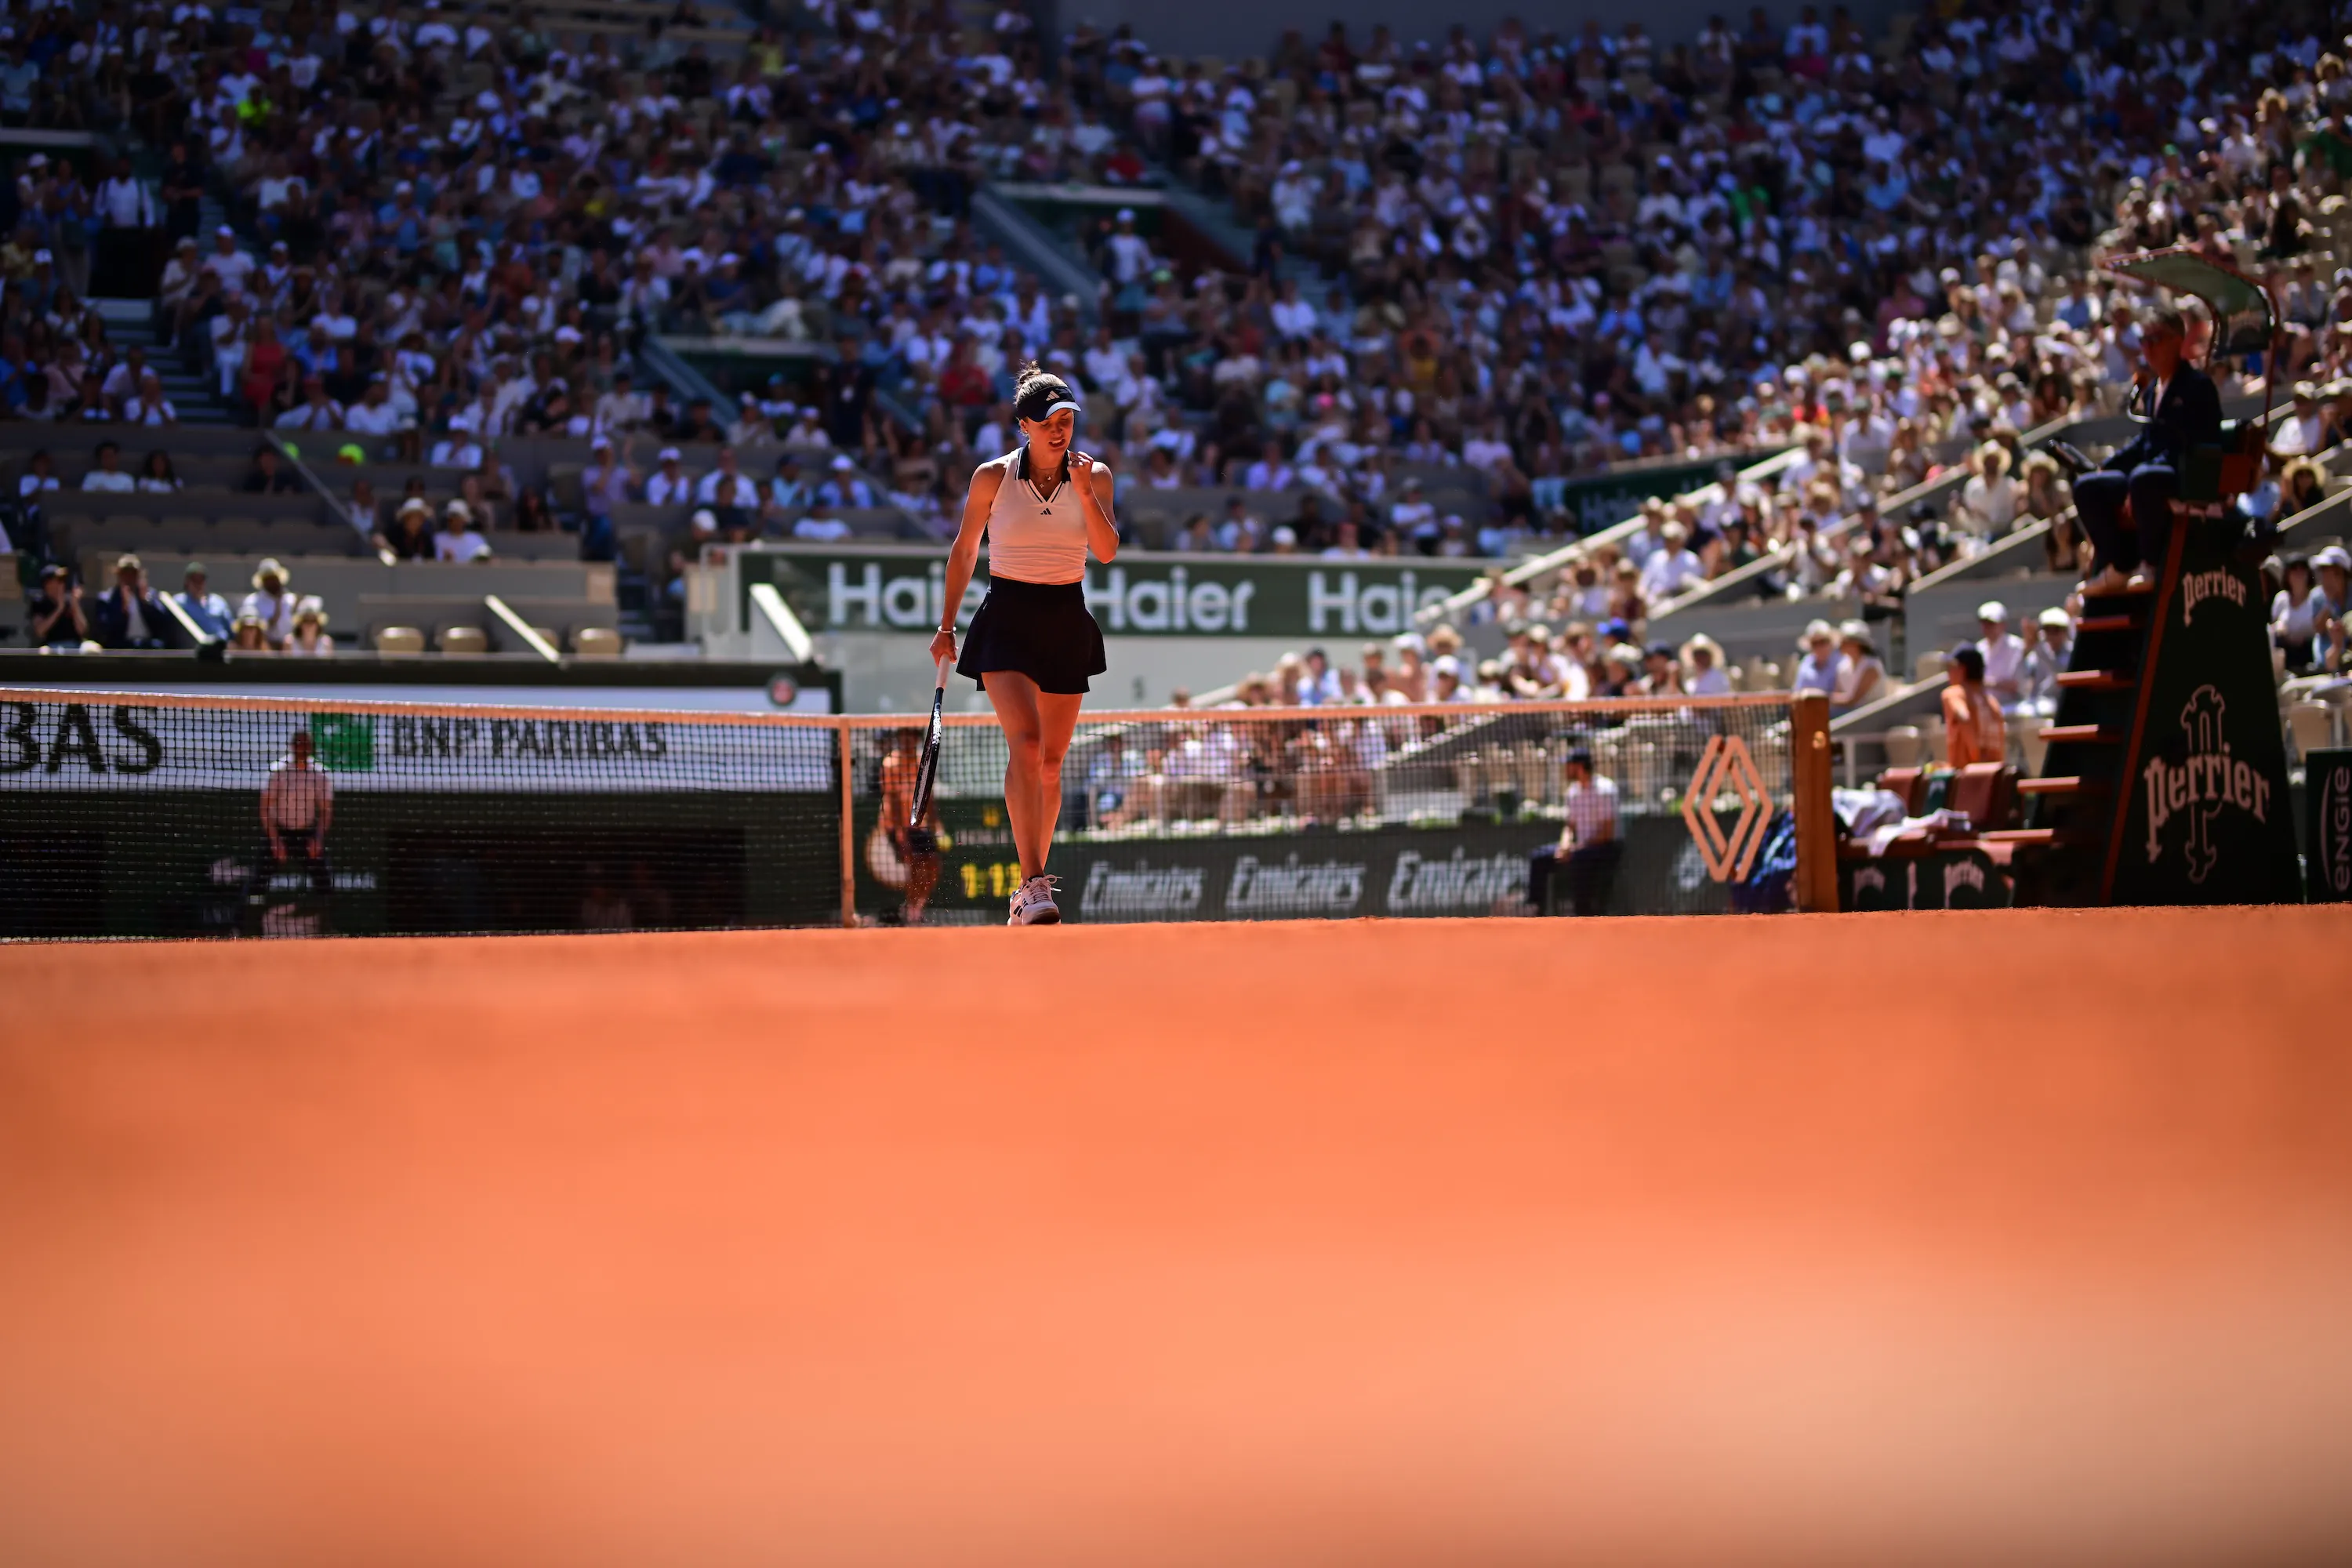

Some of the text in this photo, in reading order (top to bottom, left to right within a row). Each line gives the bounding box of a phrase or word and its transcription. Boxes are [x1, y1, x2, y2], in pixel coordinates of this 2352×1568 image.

[828, 562, 991, 626] Haie
[1082, 566, 1255, 630] Haier
[1308, 571, 1460, 633] Hai
[393, 713, 665, 760] BNP PARIBAS
[2143, 742, 2270, 863] Perrier
